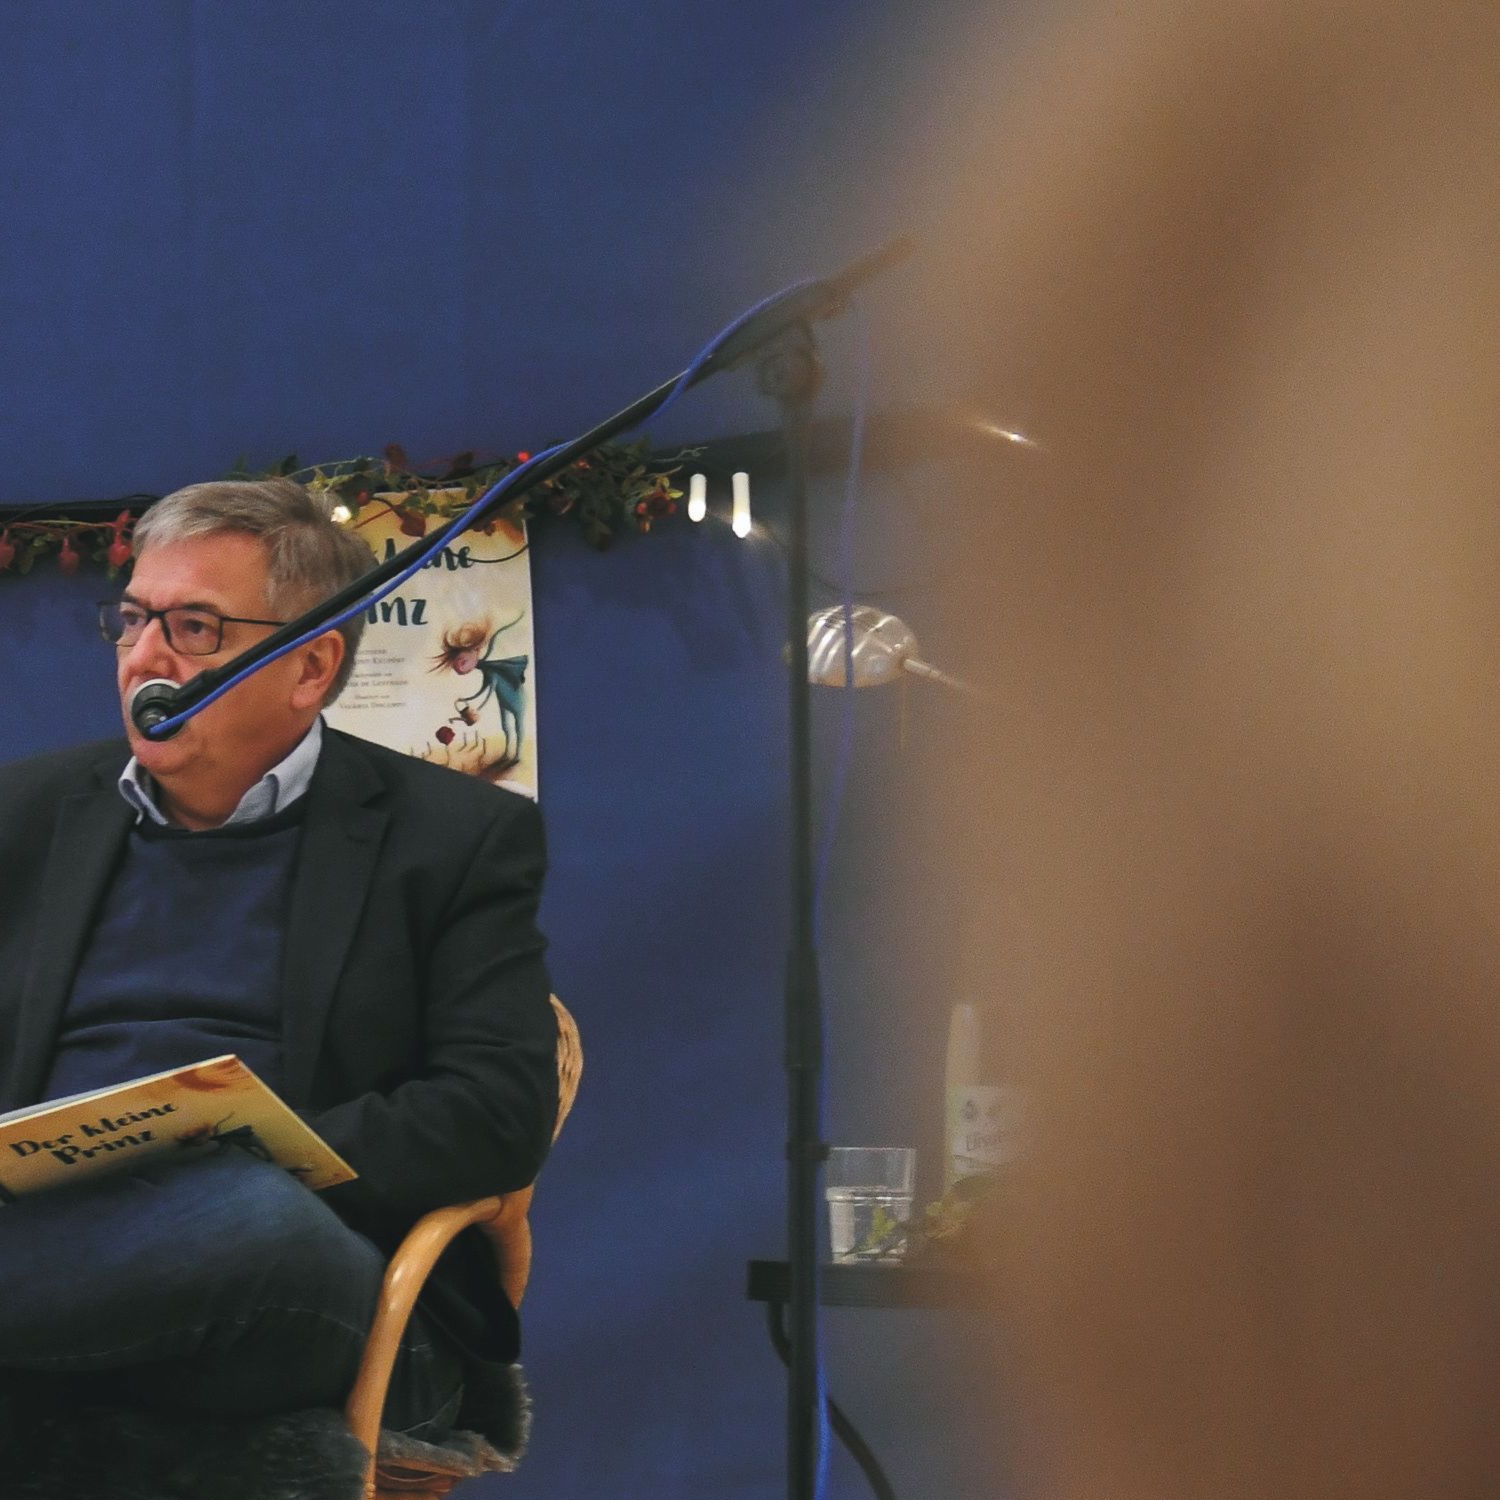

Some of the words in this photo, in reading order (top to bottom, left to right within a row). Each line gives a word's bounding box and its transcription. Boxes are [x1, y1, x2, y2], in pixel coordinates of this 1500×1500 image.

[366, 596, 429, 627] inz
[9, 1134, 74, 1157] Der
[78, 1103, 178, 1138] kleine
[51, 1130, 157, 1165] Prinz
